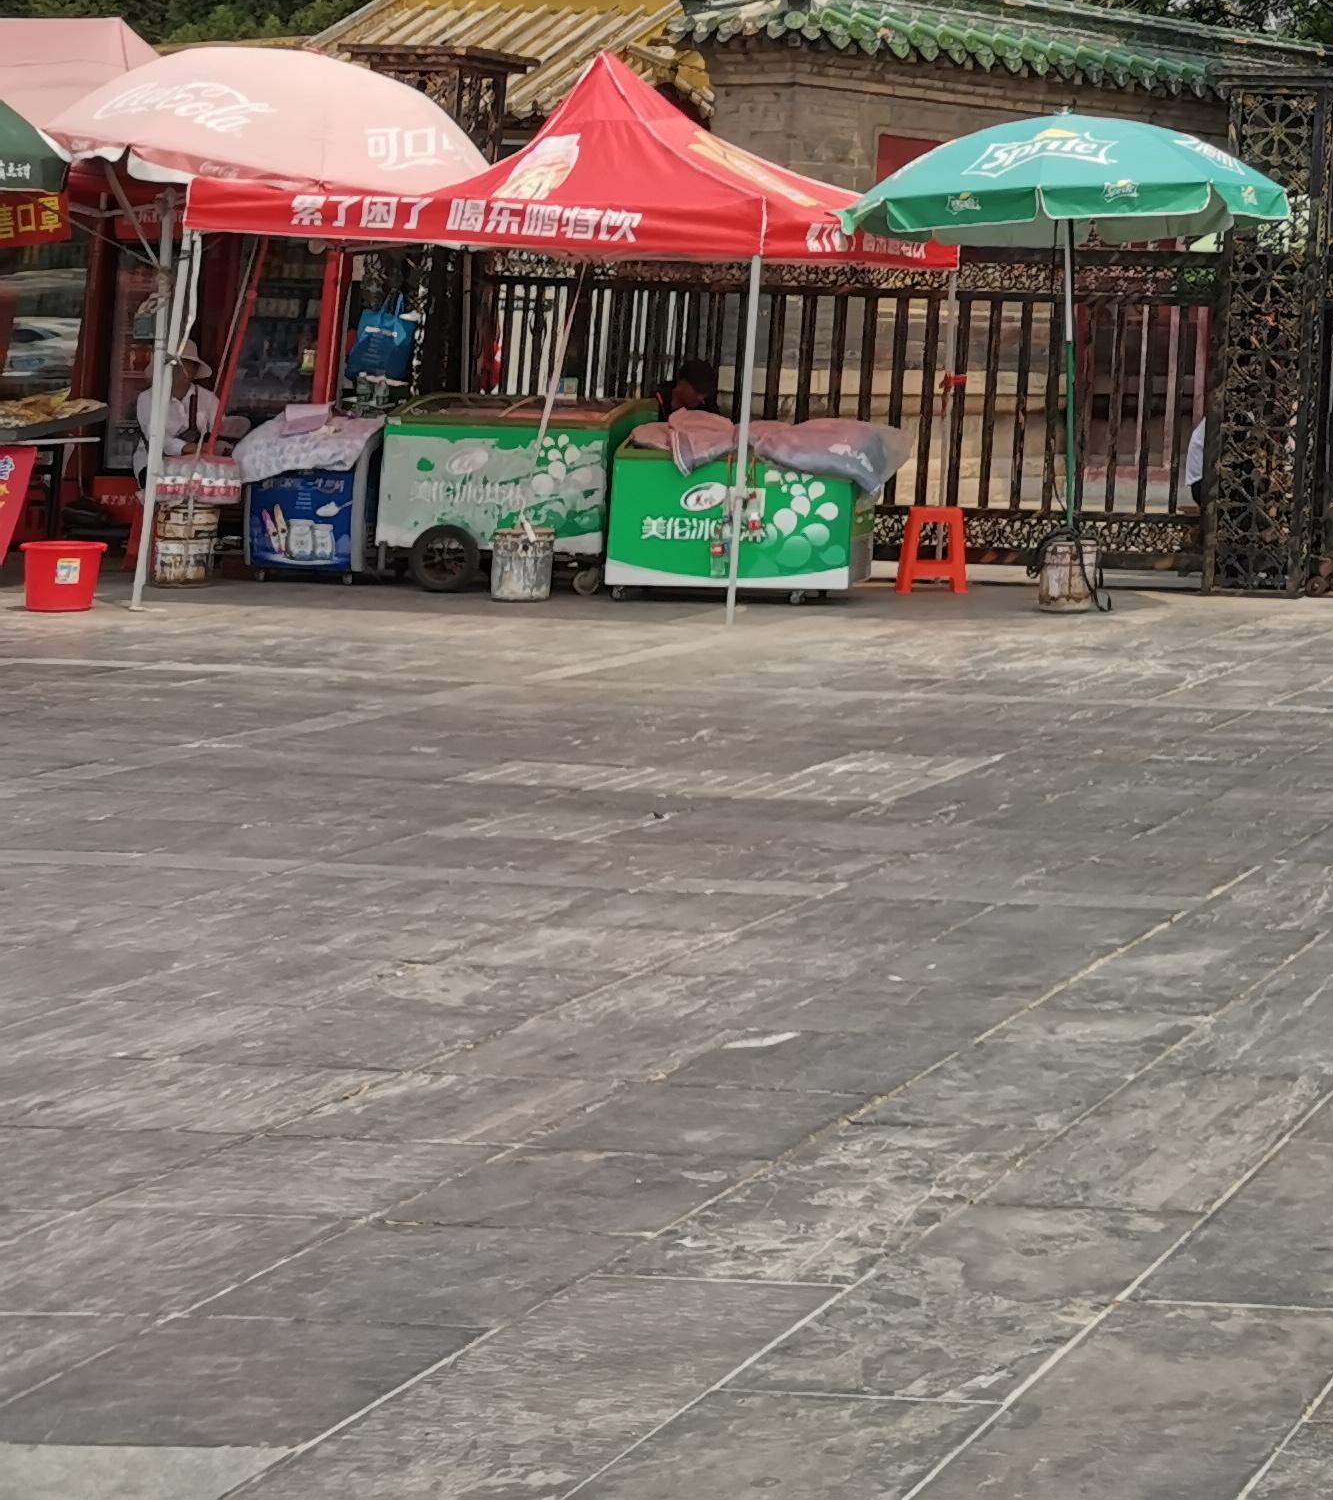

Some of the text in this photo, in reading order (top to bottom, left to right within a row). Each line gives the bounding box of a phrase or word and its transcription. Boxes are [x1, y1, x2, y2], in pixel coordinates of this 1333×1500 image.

[981, 136, 1098, 170] Sprite
[289, 194, 643, 244] 累了困了 喝东鹏特饮
[641, 516, 767, 543] 美伦冰
